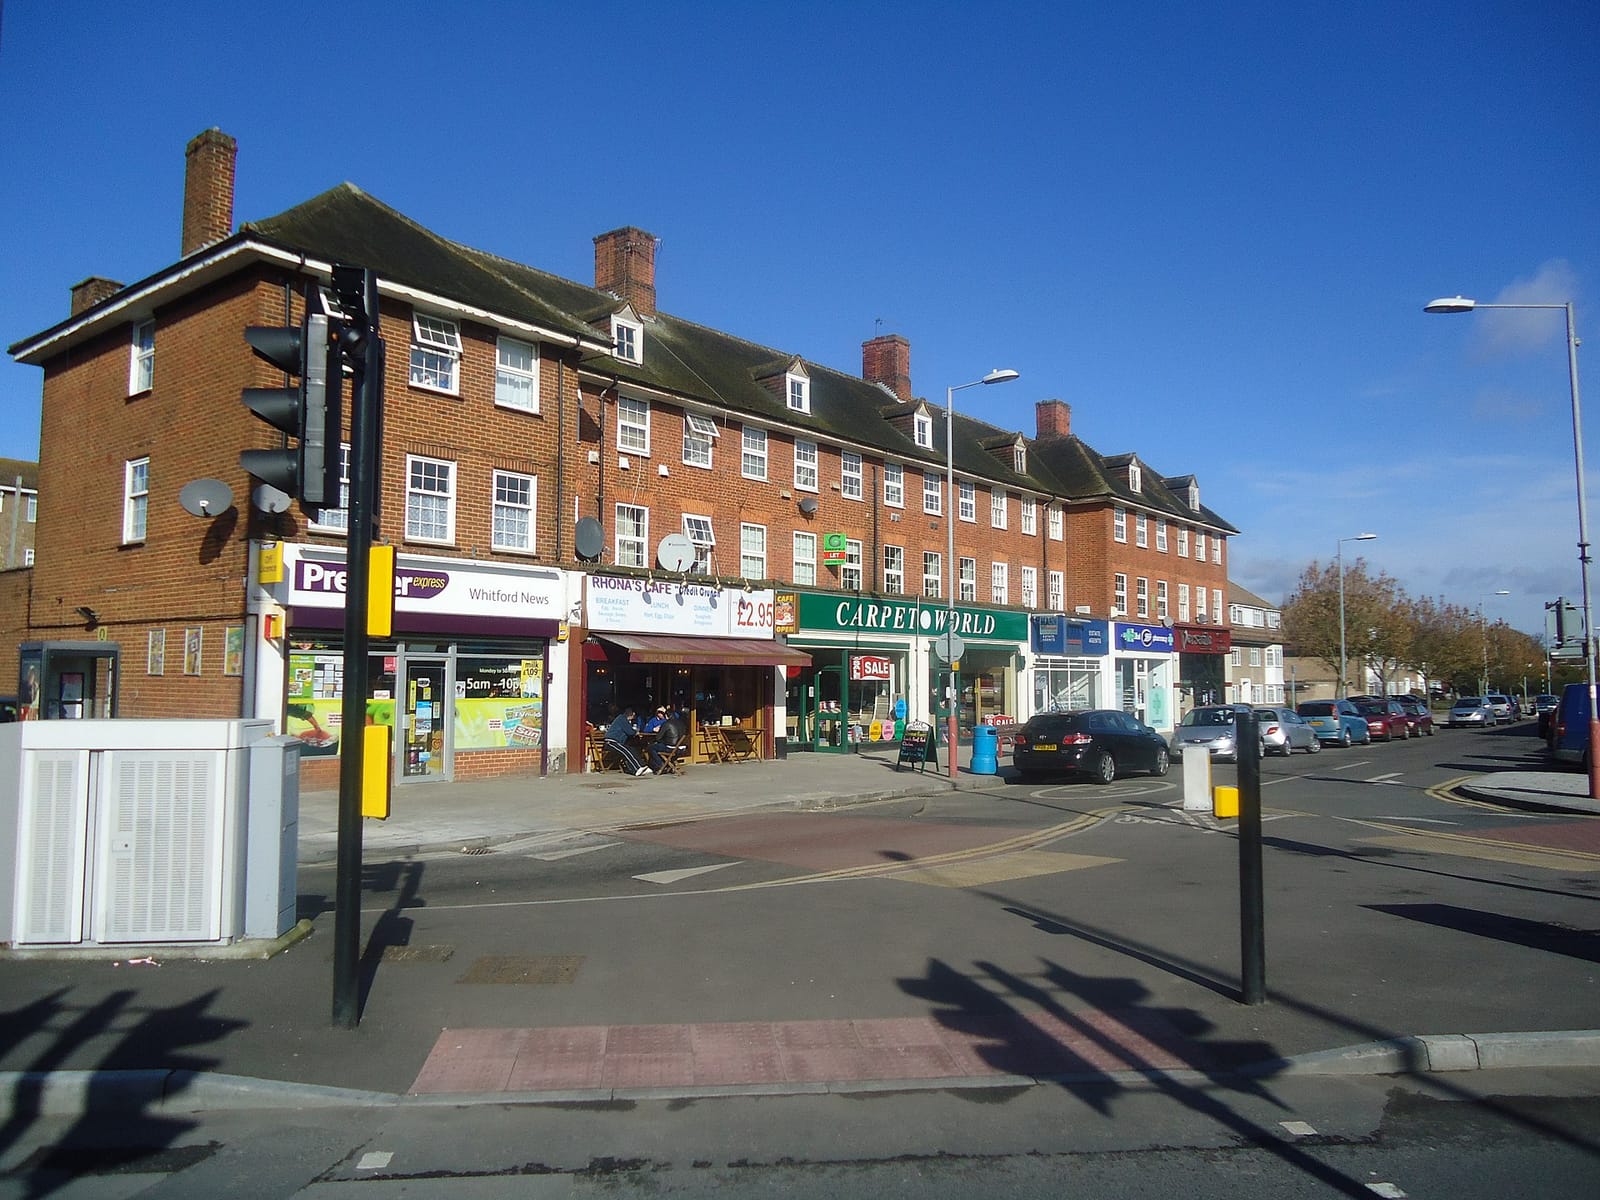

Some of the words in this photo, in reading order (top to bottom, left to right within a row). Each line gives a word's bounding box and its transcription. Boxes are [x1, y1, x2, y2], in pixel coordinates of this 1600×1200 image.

[413, 575, 445, 589] express
[592, 577, 642, 591] RHONA'S
[644, 580, 672, 594] CAFE
[469, 588, 518, 603] Whitford
[521, 592, 549, 605] News
[737, 601, 773, 627] £2.95
[836, 601, 918, 629] CARPET
[934, 609, 996, 635] WORLD
[864, 661, 889, 675] SALE
[466, 678, 490, 690] 5am
